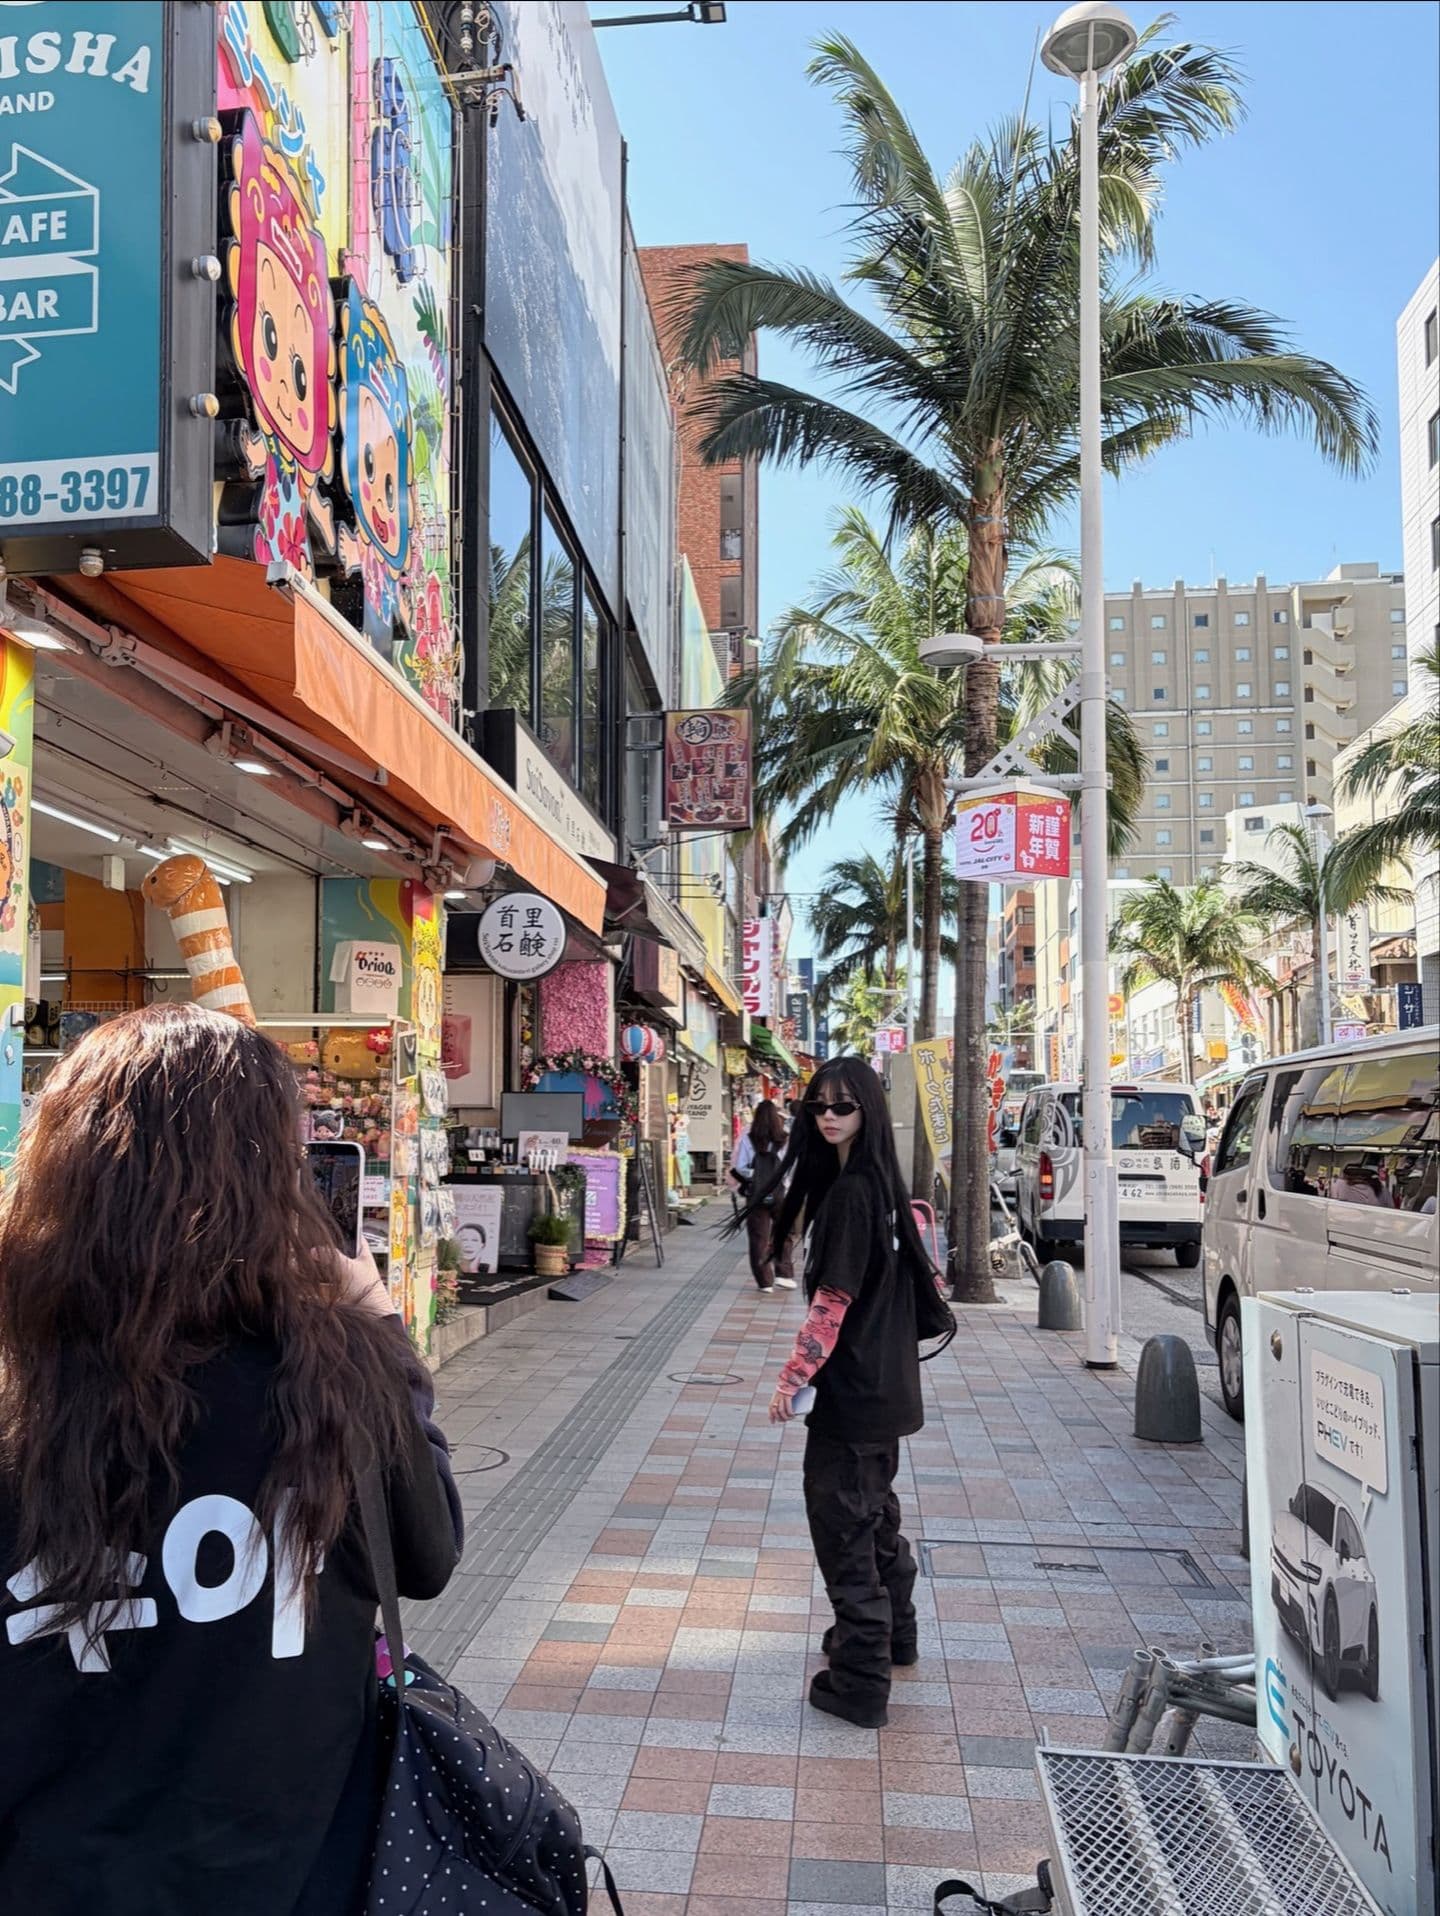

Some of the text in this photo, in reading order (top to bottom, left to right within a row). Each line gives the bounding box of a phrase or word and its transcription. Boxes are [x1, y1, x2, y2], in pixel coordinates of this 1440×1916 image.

[0, 466, 150, 518] 88-3397
[497, 905, 544, 928] 首里
[1292, 1709, 1392, 1874] TOYOTA
